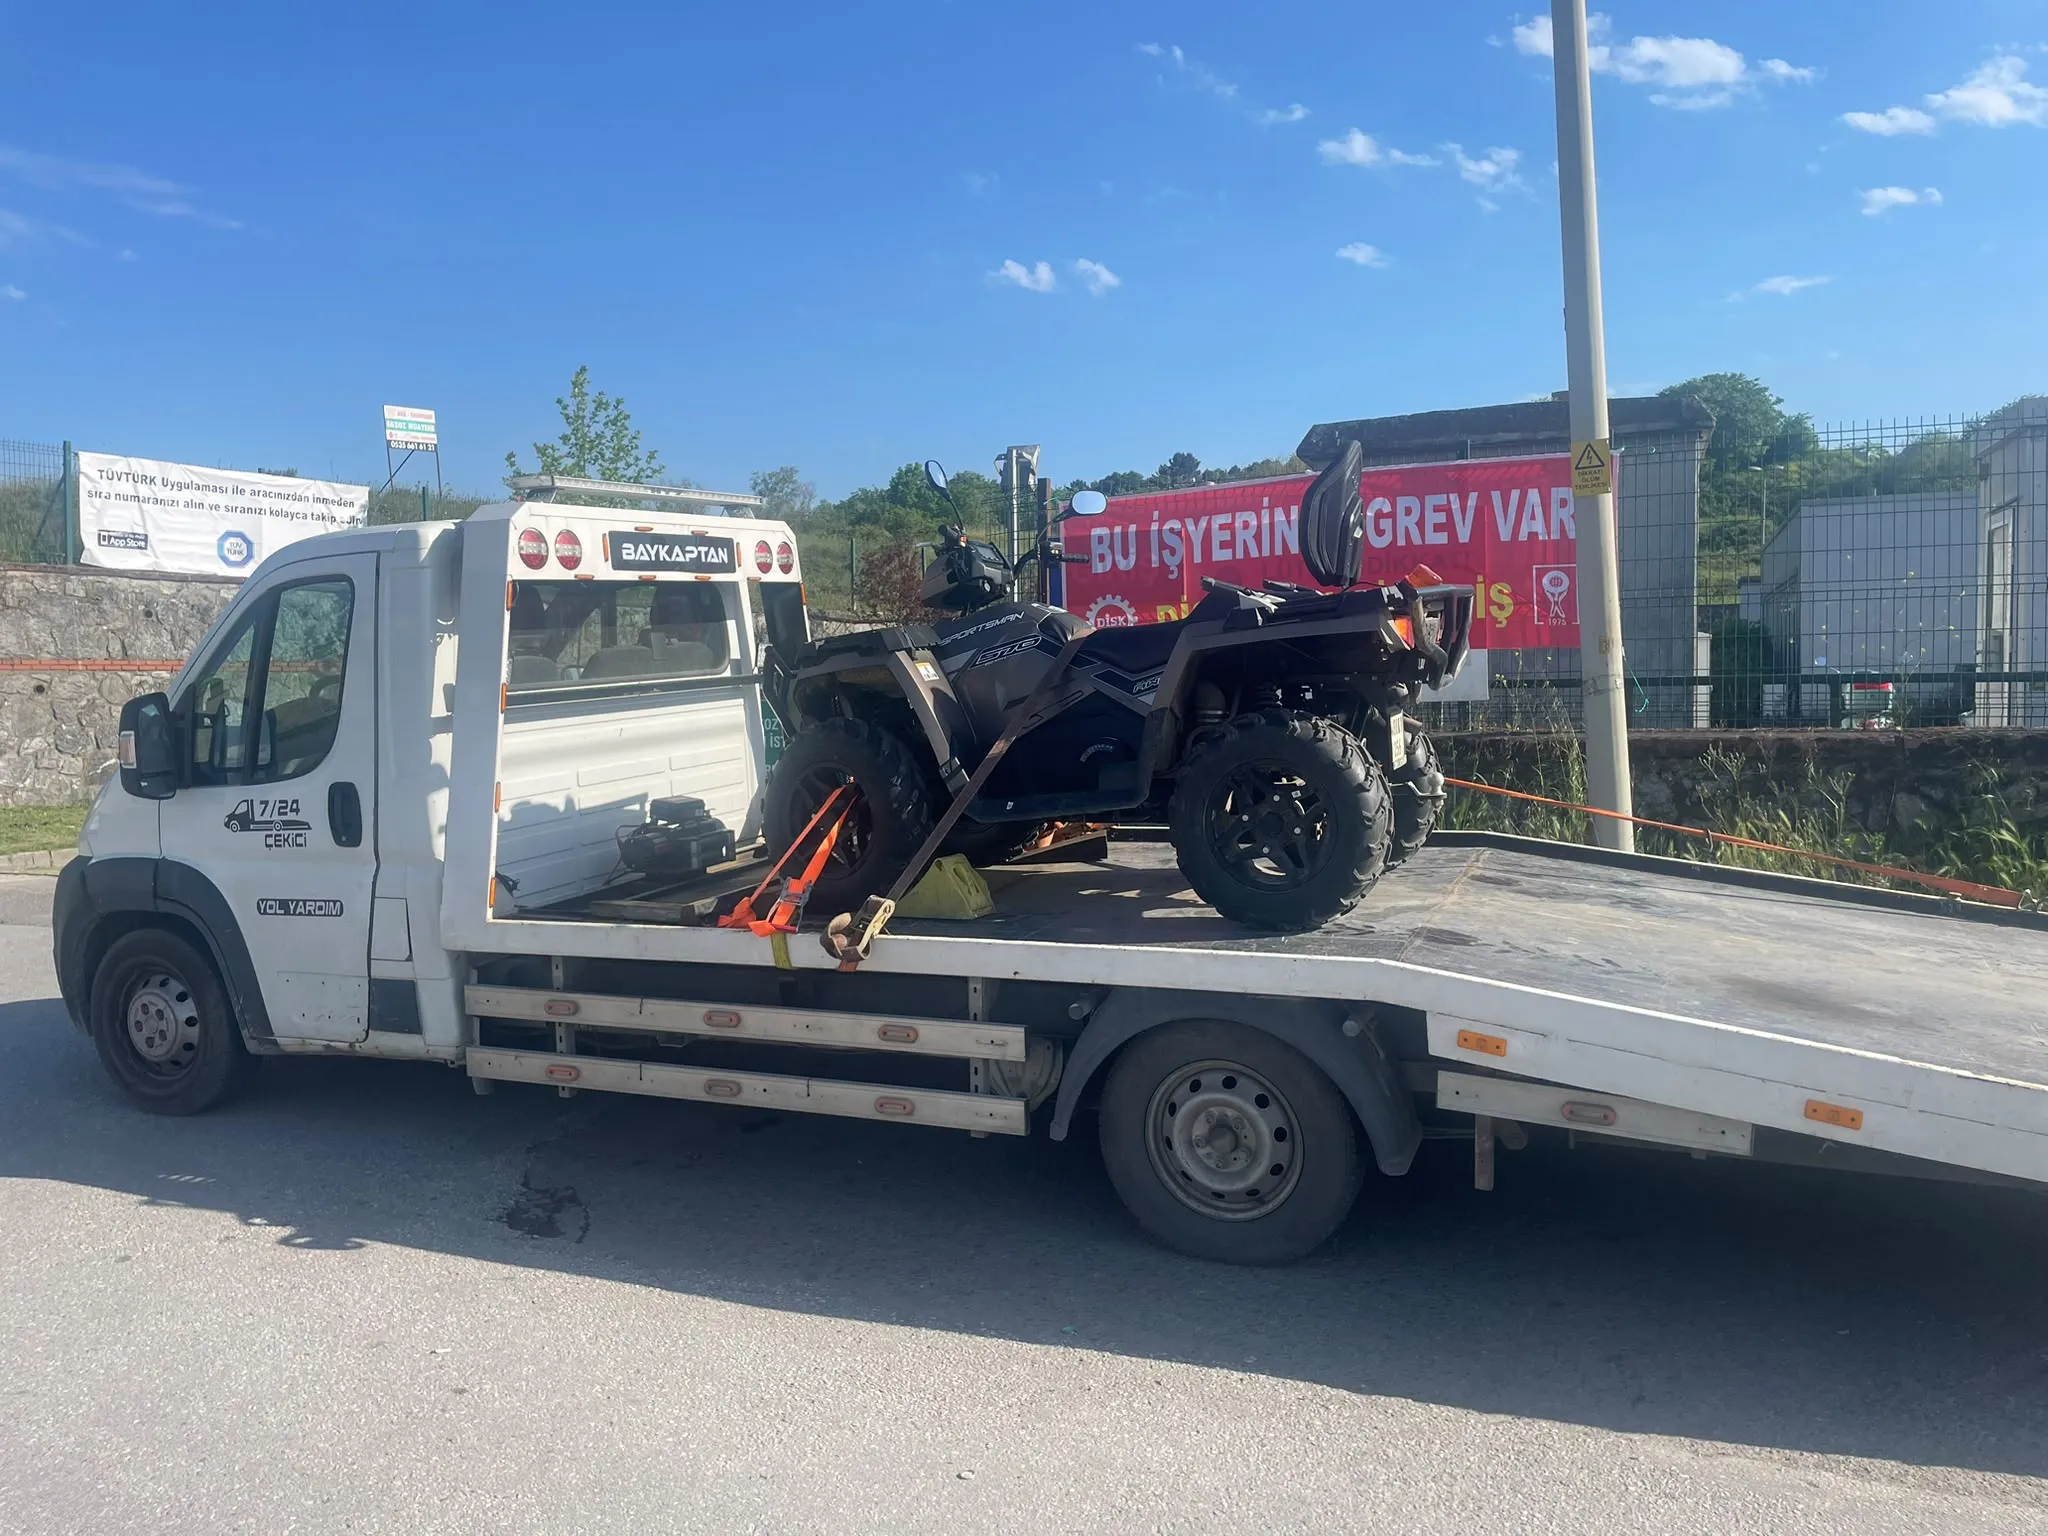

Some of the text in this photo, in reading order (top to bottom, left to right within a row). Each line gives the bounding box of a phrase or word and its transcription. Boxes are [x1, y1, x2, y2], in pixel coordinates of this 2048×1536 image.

[97, 468, 355, 508] TÜVTÜRK Uygulaması ile aracınızdan inmeden
[87, 489, 111, 500] sıra
[114, 492, 180, 507] numaranızı
[183, 498, 205, 510] alın
[208, 502, 221, 512] ve
[224, 504, 267, 516] sıranızı
[269, 507, 308, 521] kolayca
[310, 511, 337, 525] takip
[1090, 523, 1137, 574] BU
[1366, 491, 1478, 549] GREV
[1490, 486, 1576, 542] VAR
[110, 536, 126, 547] App
[621, 542, 729, 564] BAYKAPTAN
[940, 610, 1025, 647] SPORTSMAN
[1096, 612, 1127, 628] DİSK
[1547, 618, 1567, 626] 1975
[259, 799, 301, 818] 7/24
[258, 900, 341, 915] YOL YARDIM
